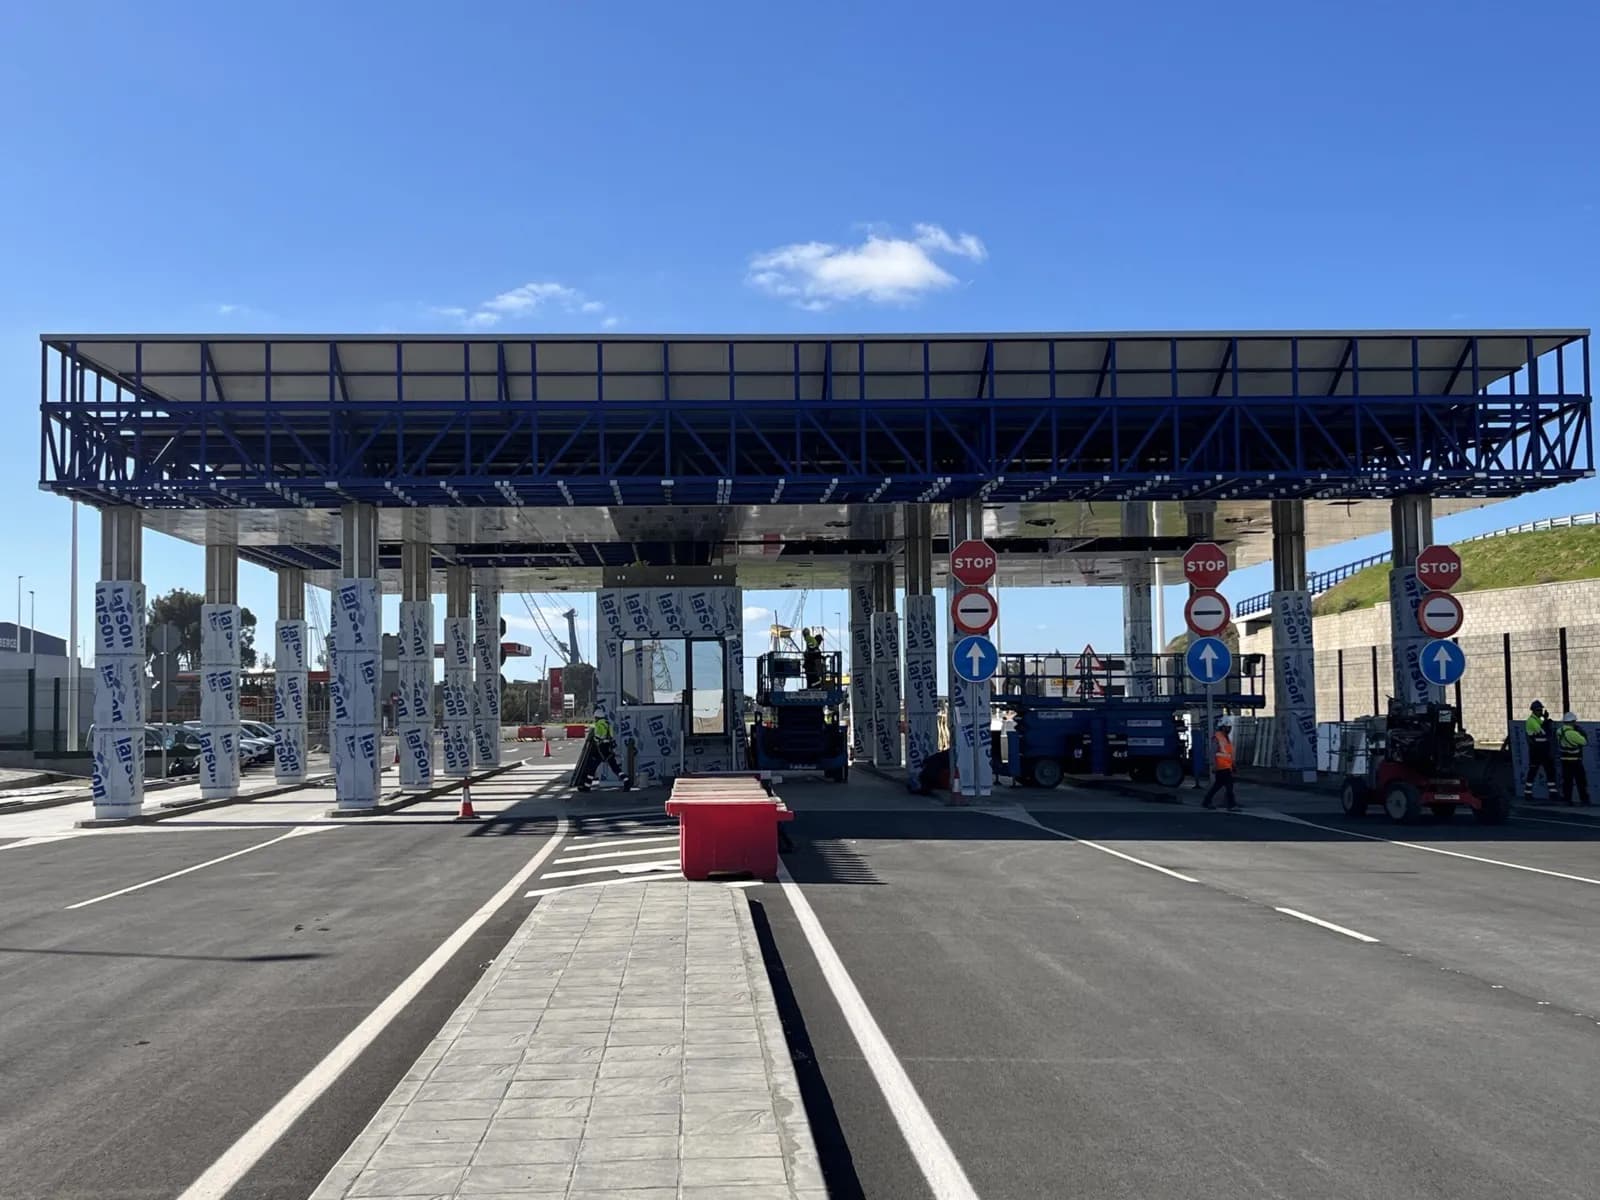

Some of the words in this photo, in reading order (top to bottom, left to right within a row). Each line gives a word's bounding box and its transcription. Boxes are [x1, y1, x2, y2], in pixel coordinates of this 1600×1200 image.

[955, 557, 993, 569] STOP
[1187, 561, 1225, 572] STOP
[1420, 562, 1459, 574] STOP
[113, 588, 133, 648] larson
[407, 728, 430, 778] larson
